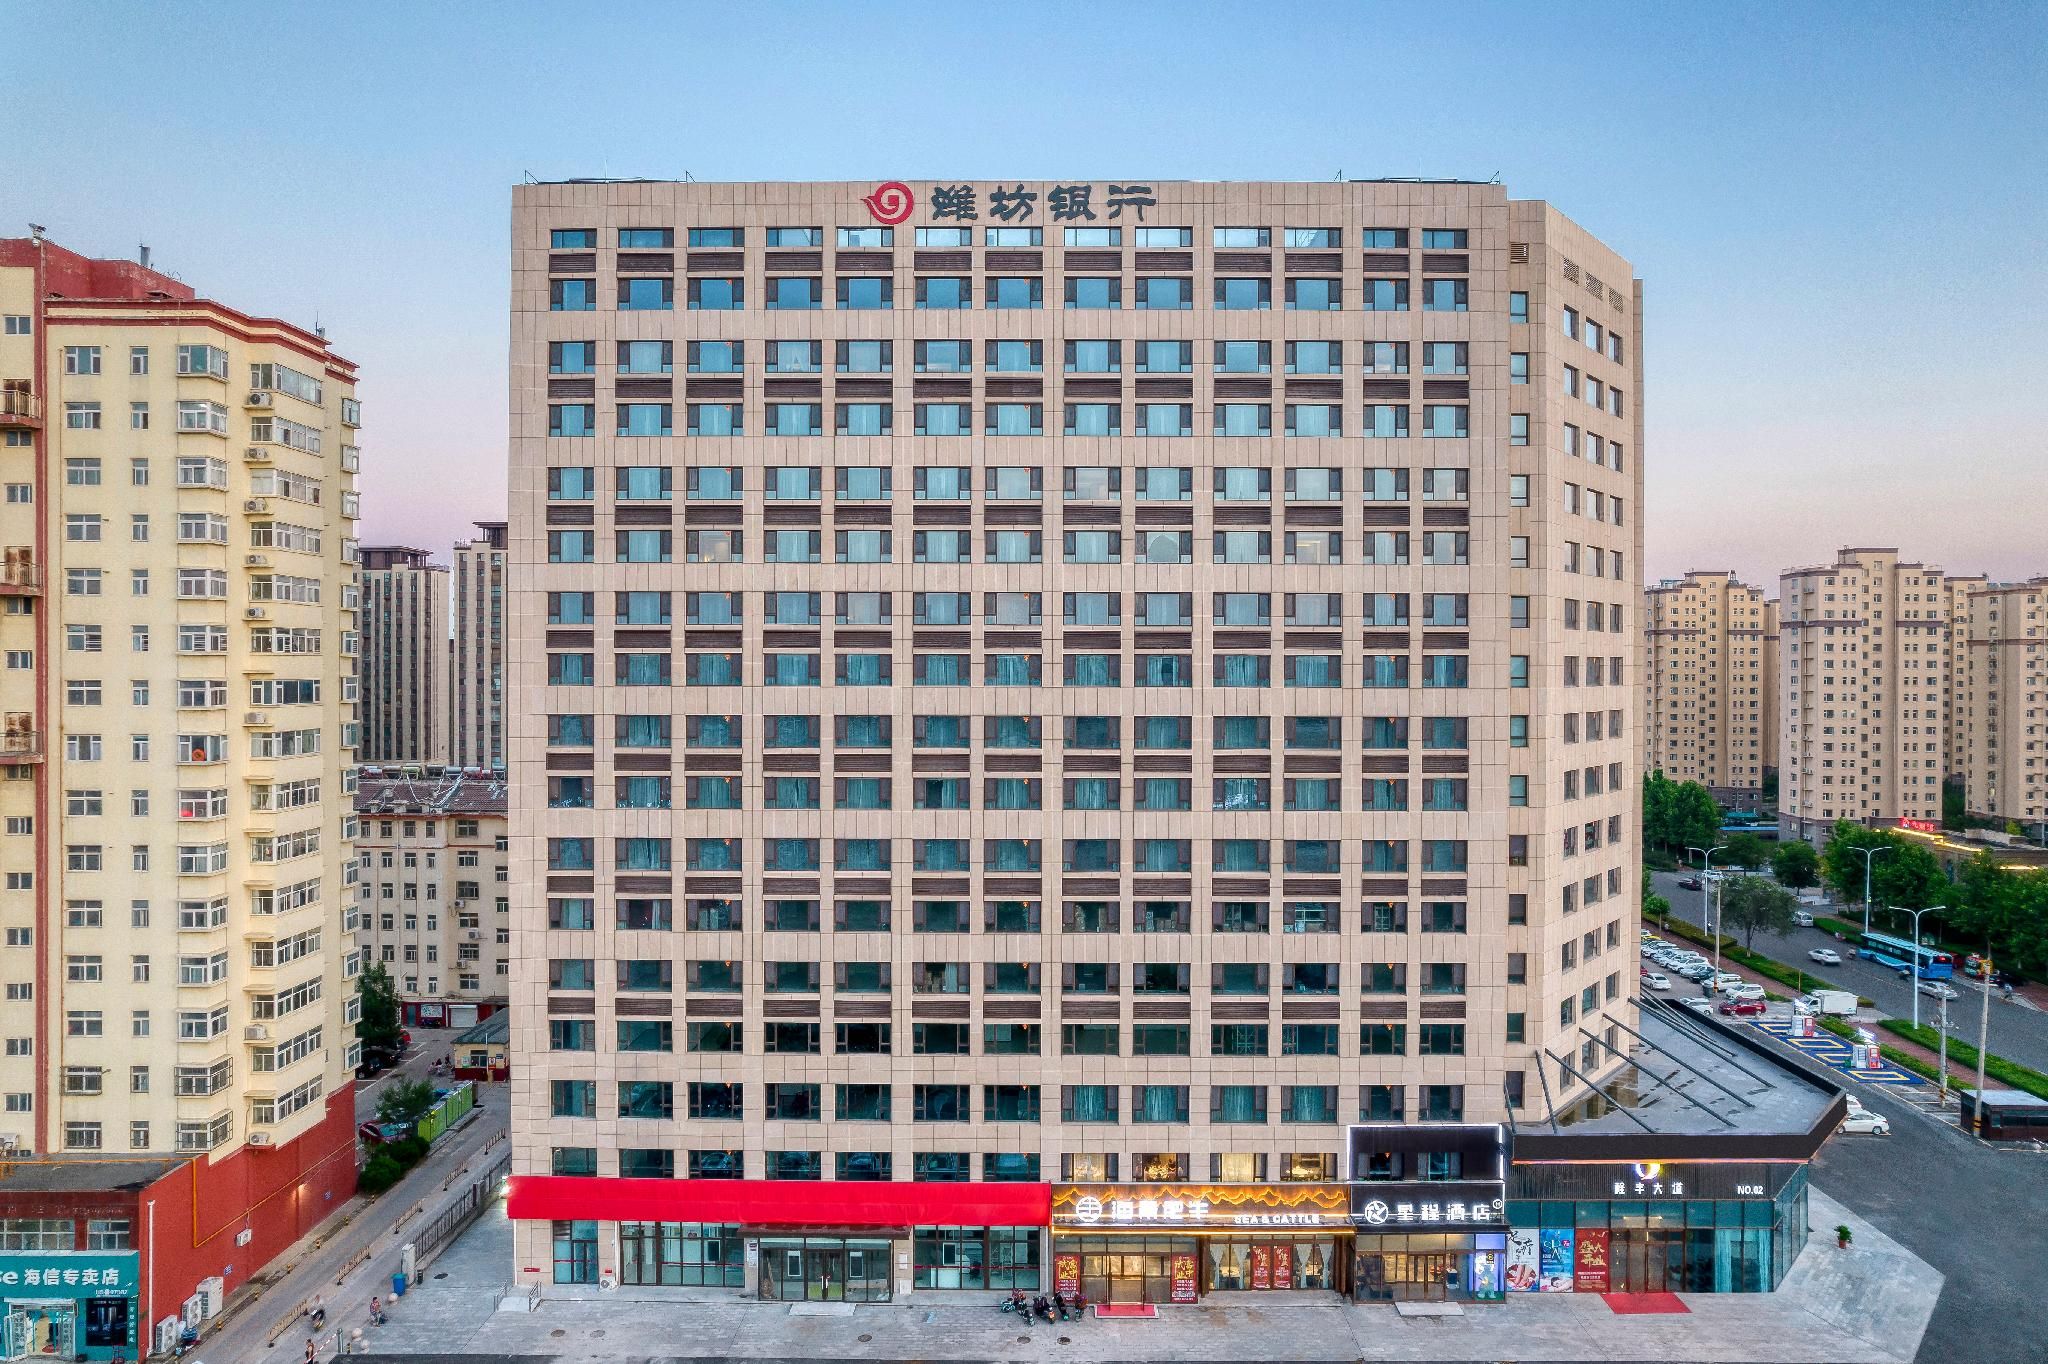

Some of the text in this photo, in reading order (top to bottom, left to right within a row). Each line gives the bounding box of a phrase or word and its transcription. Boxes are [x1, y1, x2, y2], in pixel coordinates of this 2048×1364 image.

[1397, 1203, 1490, 1221] 星程酒店
[24, 1268, 119, 1286] 海信专卖店
